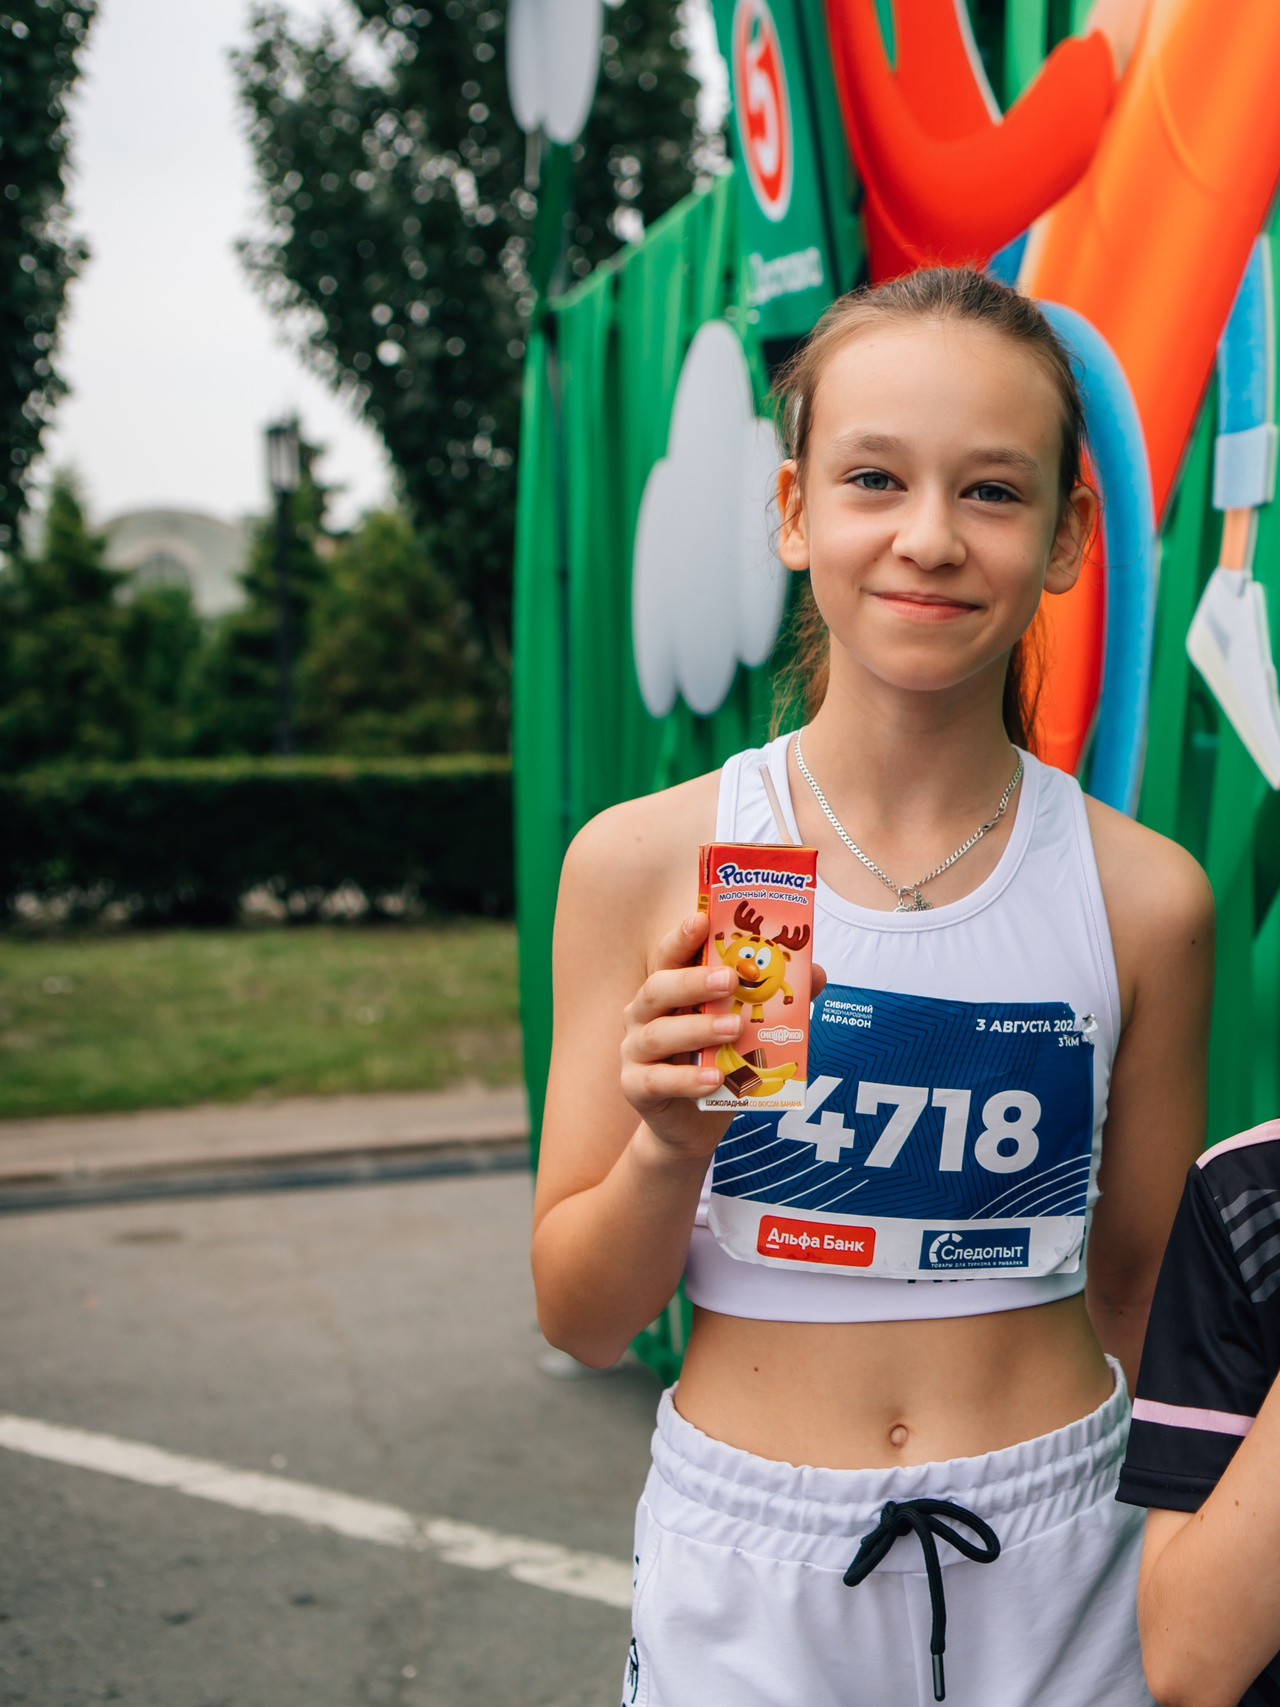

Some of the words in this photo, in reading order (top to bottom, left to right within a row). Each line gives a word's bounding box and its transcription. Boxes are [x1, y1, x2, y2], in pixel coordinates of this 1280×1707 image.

[718, 863, 806, 889] Растишка
[719, 890, 767, 901] МОЛОЧНЫЙ
[769, 892, 808, 905] КОКТЕЙЛЬ
[824, 1000, 874, 1013] СИБИРСКИЙ
[821, 1013, 871, 1028] МАРАФОН
[975, 1018, 986, 1031] 3
[989, 1020, 1051, 1033] АВГУСТА
[1053, 1020, 1075, 1032] 202
[1058, 1037, 1064, 1047] 3
[1065, 1036, 1080, 1047] КМ
[705, 1099, 749, 1108] ШОКОЛАДНЫЙ
[776, 1074, 1041, 1174] 4718
[766, 1227, 820, 1251] Альфа
[823, 1234, 865, 1253] Банк
[941, 1245, 1024, 1261] Следопыт
